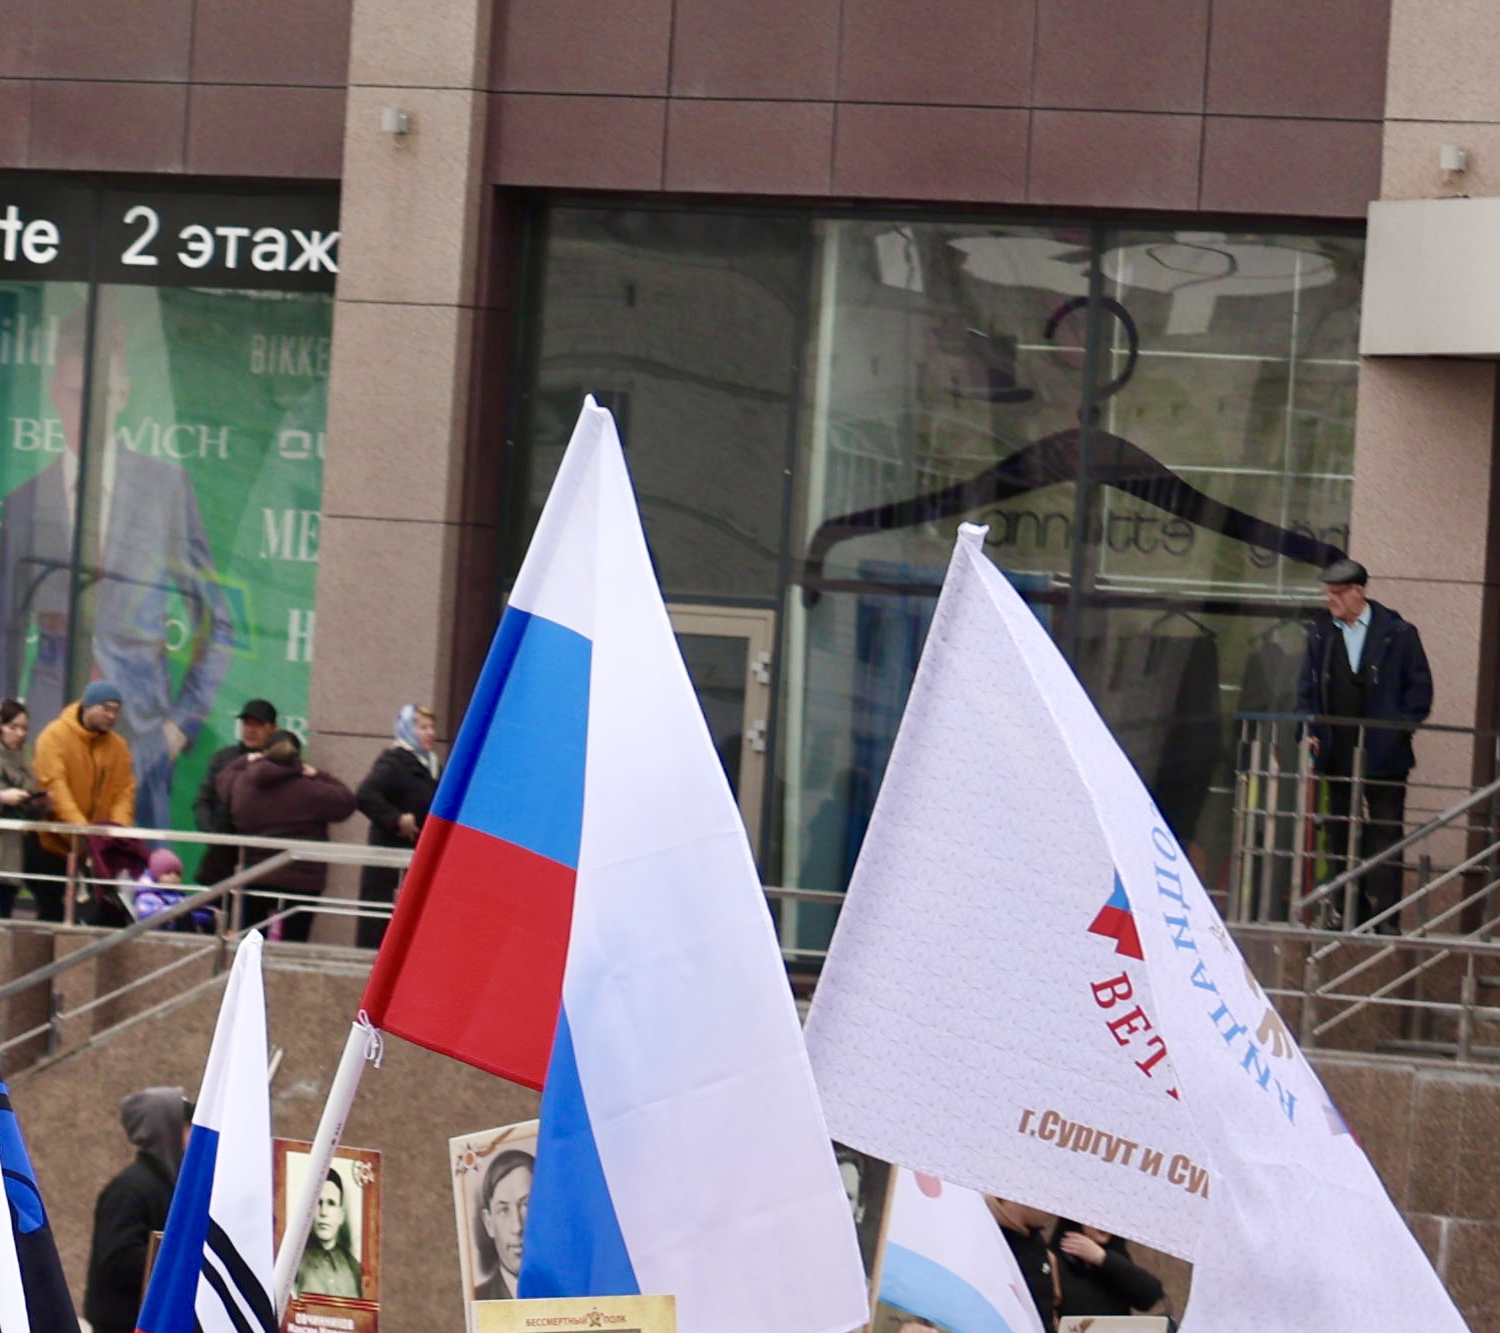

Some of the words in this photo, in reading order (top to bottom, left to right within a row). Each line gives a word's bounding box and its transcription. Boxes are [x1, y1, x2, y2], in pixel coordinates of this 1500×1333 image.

[120, 205, 156, 265] 2
[177, 226, 341, 272] этаж
[251, 334, 327, 377] BIKKE
[983, 509, 1194, 555] anntte
[1018, 1108, 1138, 1167] г.Сургут
[603, 1314, 627, 1324] ПОЛК
